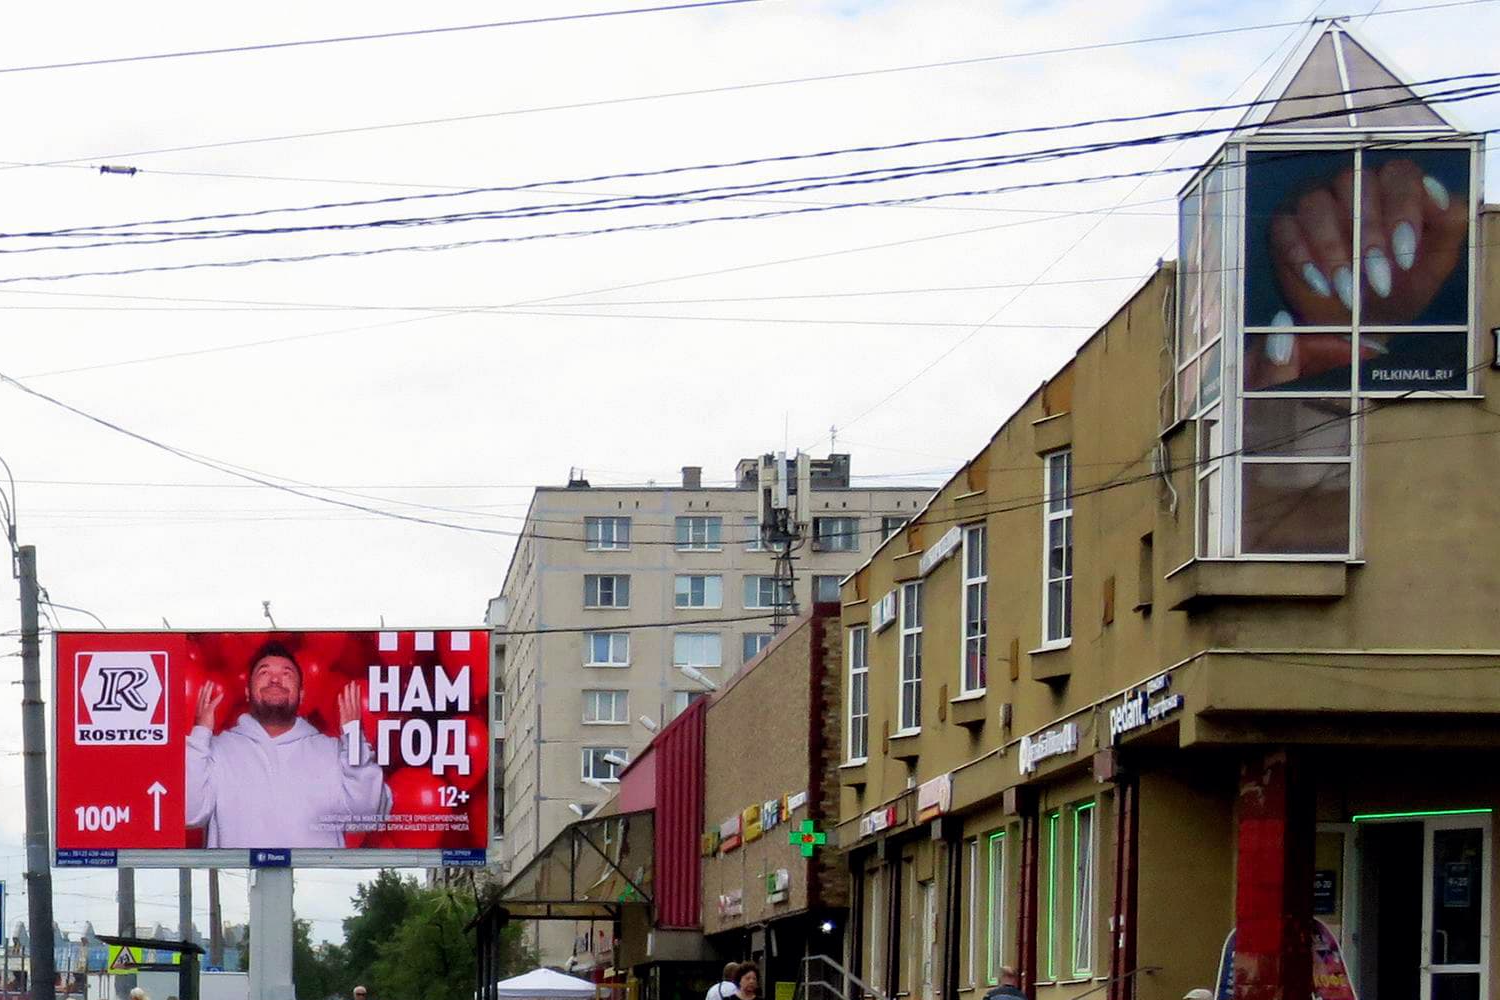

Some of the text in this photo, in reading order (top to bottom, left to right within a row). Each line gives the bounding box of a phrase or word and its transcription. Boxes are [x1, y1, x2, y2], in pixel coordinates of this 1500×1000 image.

[1371, 369, 1453, 380] PILKINAIL.RU
[92, 667, 149, 712] R
[369, 665, 470, 712] НАМ
[79, 729, 164, 741] ROSTIC'S
[344, 718, 470, 775] 1 ГОД
[438, 786, 470, 807] 12+
